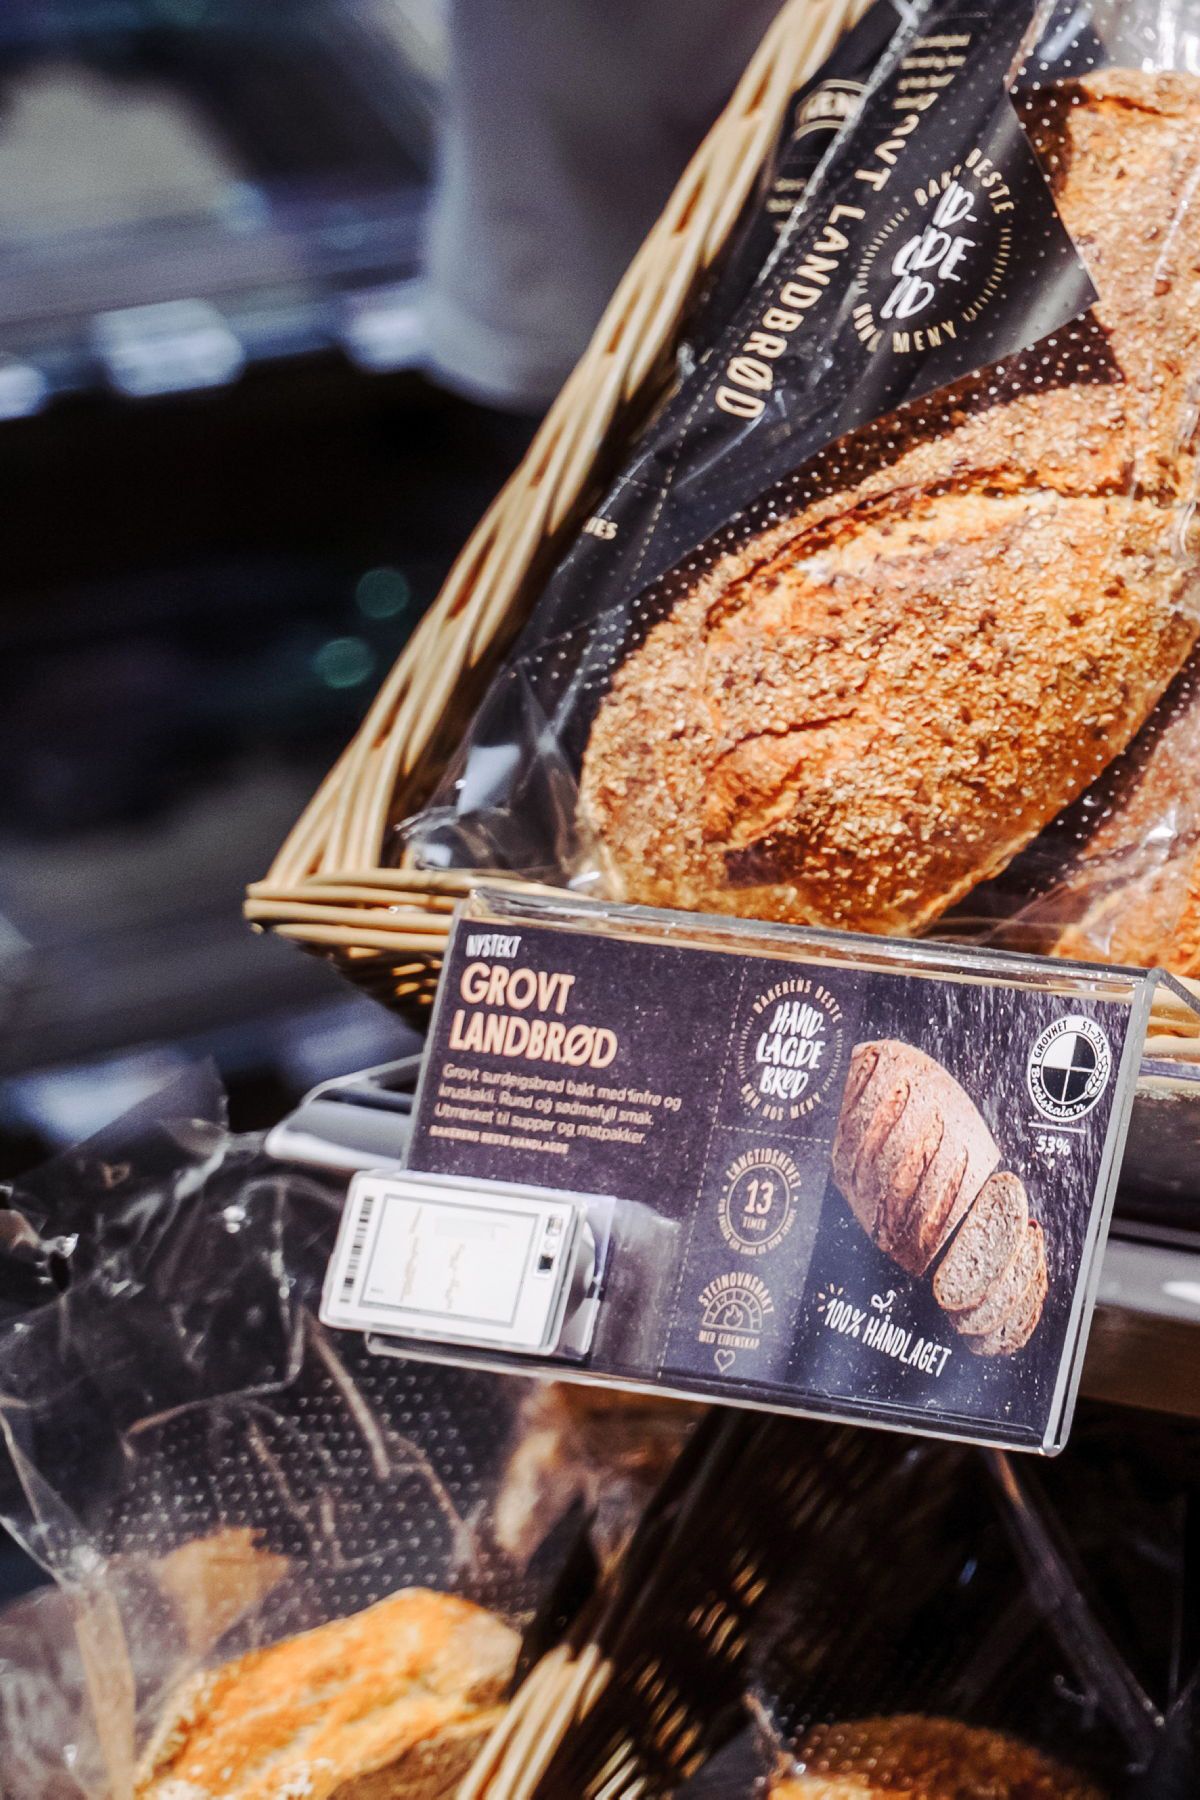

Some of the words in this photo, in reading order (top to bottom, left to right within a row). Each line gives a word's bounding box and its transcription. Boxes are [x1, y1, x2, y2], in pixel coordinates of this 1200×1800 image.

[715, 204, 865, 418] LANDBRØD
[892, 320, 957, 353] MENY
[465, 934, 522, 958] NYSTEKT
[460, 962, 576, 1015] GROVT
[752, 979, 812, 1014] BAKERENS
[449, 1009, 618, 1068] LANDBRØD
[756, 1032, 826, 1070] LAGDE
[1034, 1020, 1068, 1058] GROVHET
[442, 1063, 480, 1081] Grovt
[481, 1070, 566, 1093] surdeigsbrød
[566, 1079, 595, 1098] bakt
[596, 1086, 627, 1102] med
[663, 1096, 682, 1112] og
[759, 1065, 809, 1099] BRØD
[434, 1102, 494, 1124] Utmerket
[495, 1110, 511, 1127] til
[510, 1114, 556, 1133] supper
[556, 1121, 575, 1138] og
[576, 1124, 647, 1146] matpakker.
[498, 1090, 534, 1109] Rund
[534, 1098, 554, 1115] og
[618, 1109, 654, 1127] smak.
[790, 1091, 822, 1120] MENY
[1035, 1134, 1071, 1156] 53%
[726, 1148, 802, 1189] LANGTIDSHEVET
[744, 1178, 774, 1215] 13
[824, 1298, 867, 1338] 100%
[862, 1314, 952, 1377] HÅNDLAGET
